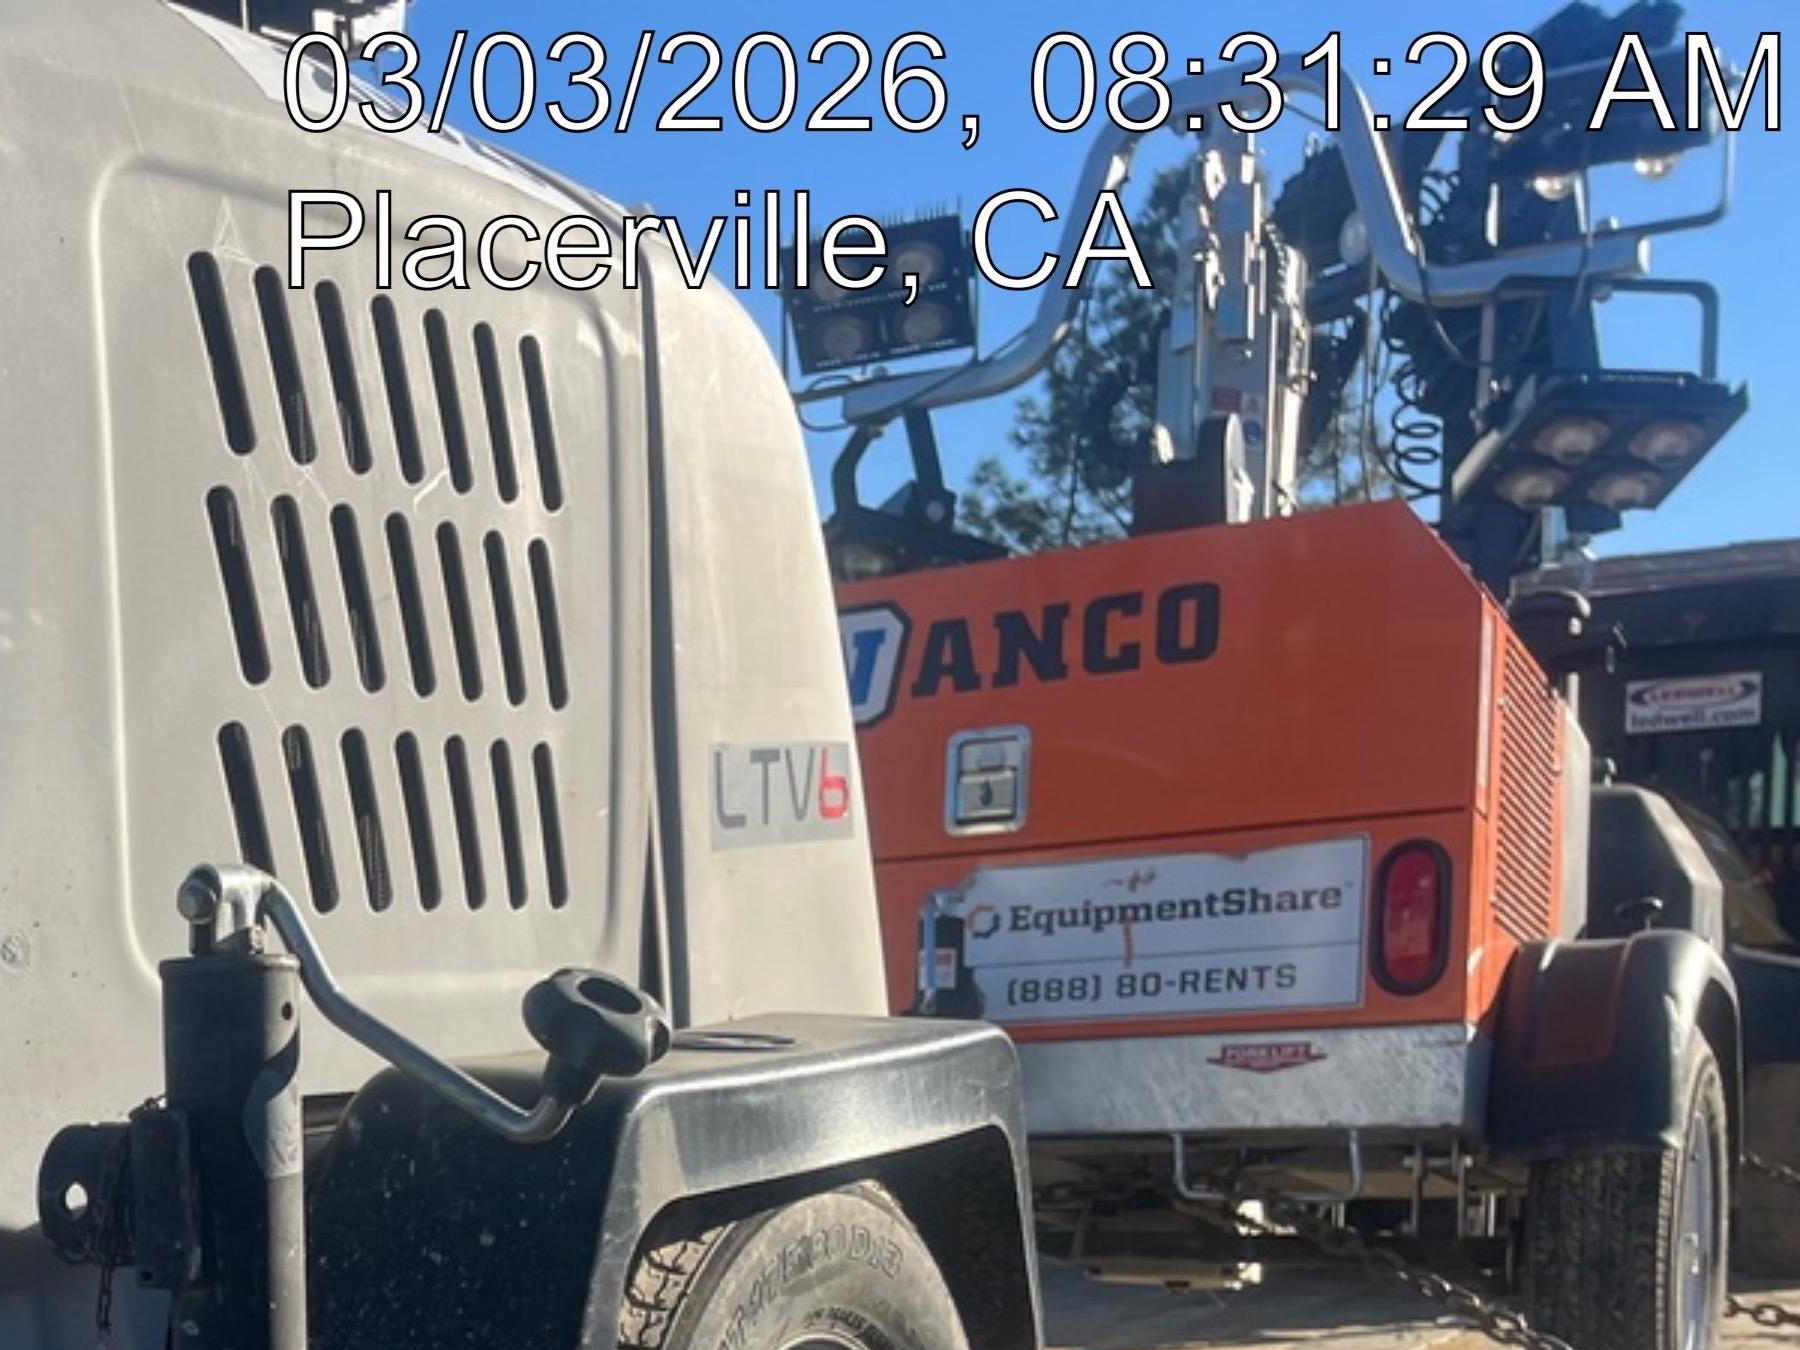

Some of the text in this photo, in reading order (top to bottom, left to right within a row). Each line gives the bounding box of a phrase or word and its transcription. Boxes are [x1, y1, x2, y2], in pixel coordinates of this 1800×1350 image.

[1008, 886, 1343, 936] EquipmentShare
[1006, 963, 1298, 1006] (888) 80-RENTS
